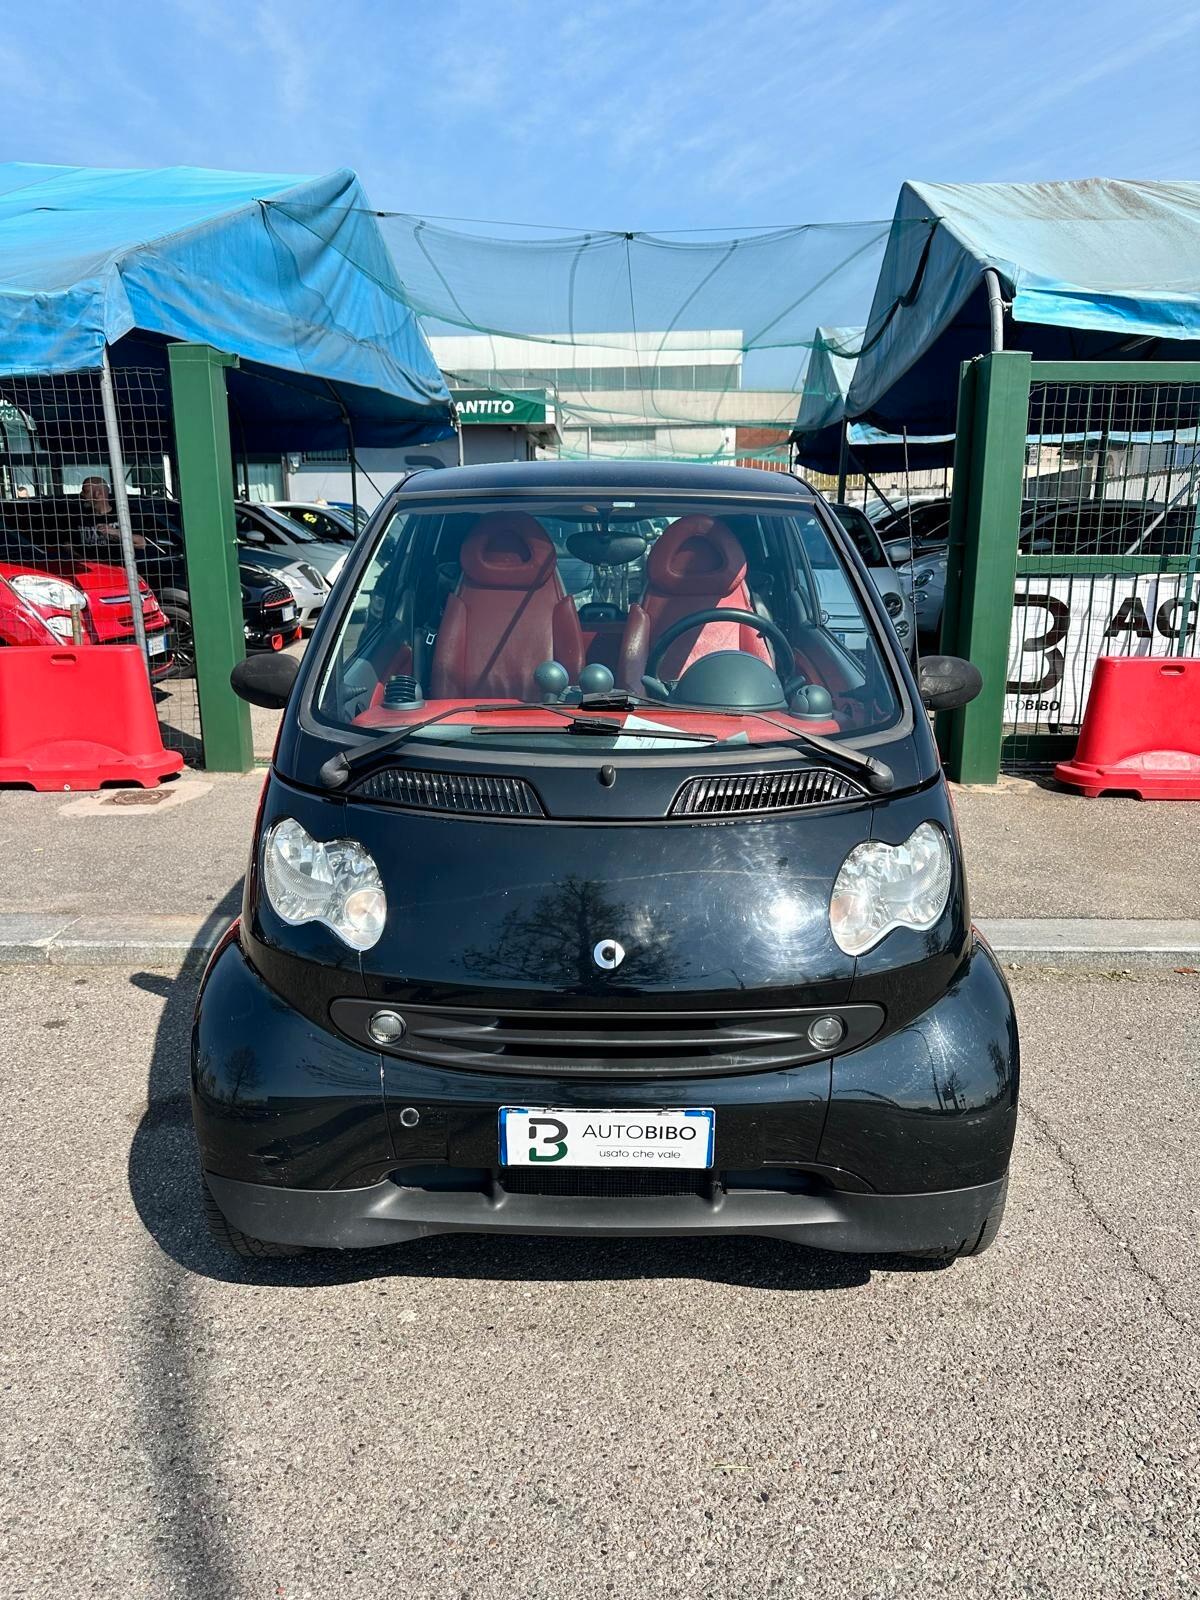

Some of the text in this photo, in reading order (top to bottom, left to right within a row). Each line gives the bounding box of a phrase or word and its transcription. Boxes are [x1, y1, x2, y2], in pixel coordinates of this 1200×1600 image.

[455, 400, 514, 414] ANTITO
[582, 1124, 697, 1140] AUTOBIBO
[599, 1150, 681, 1159] usato che vale
